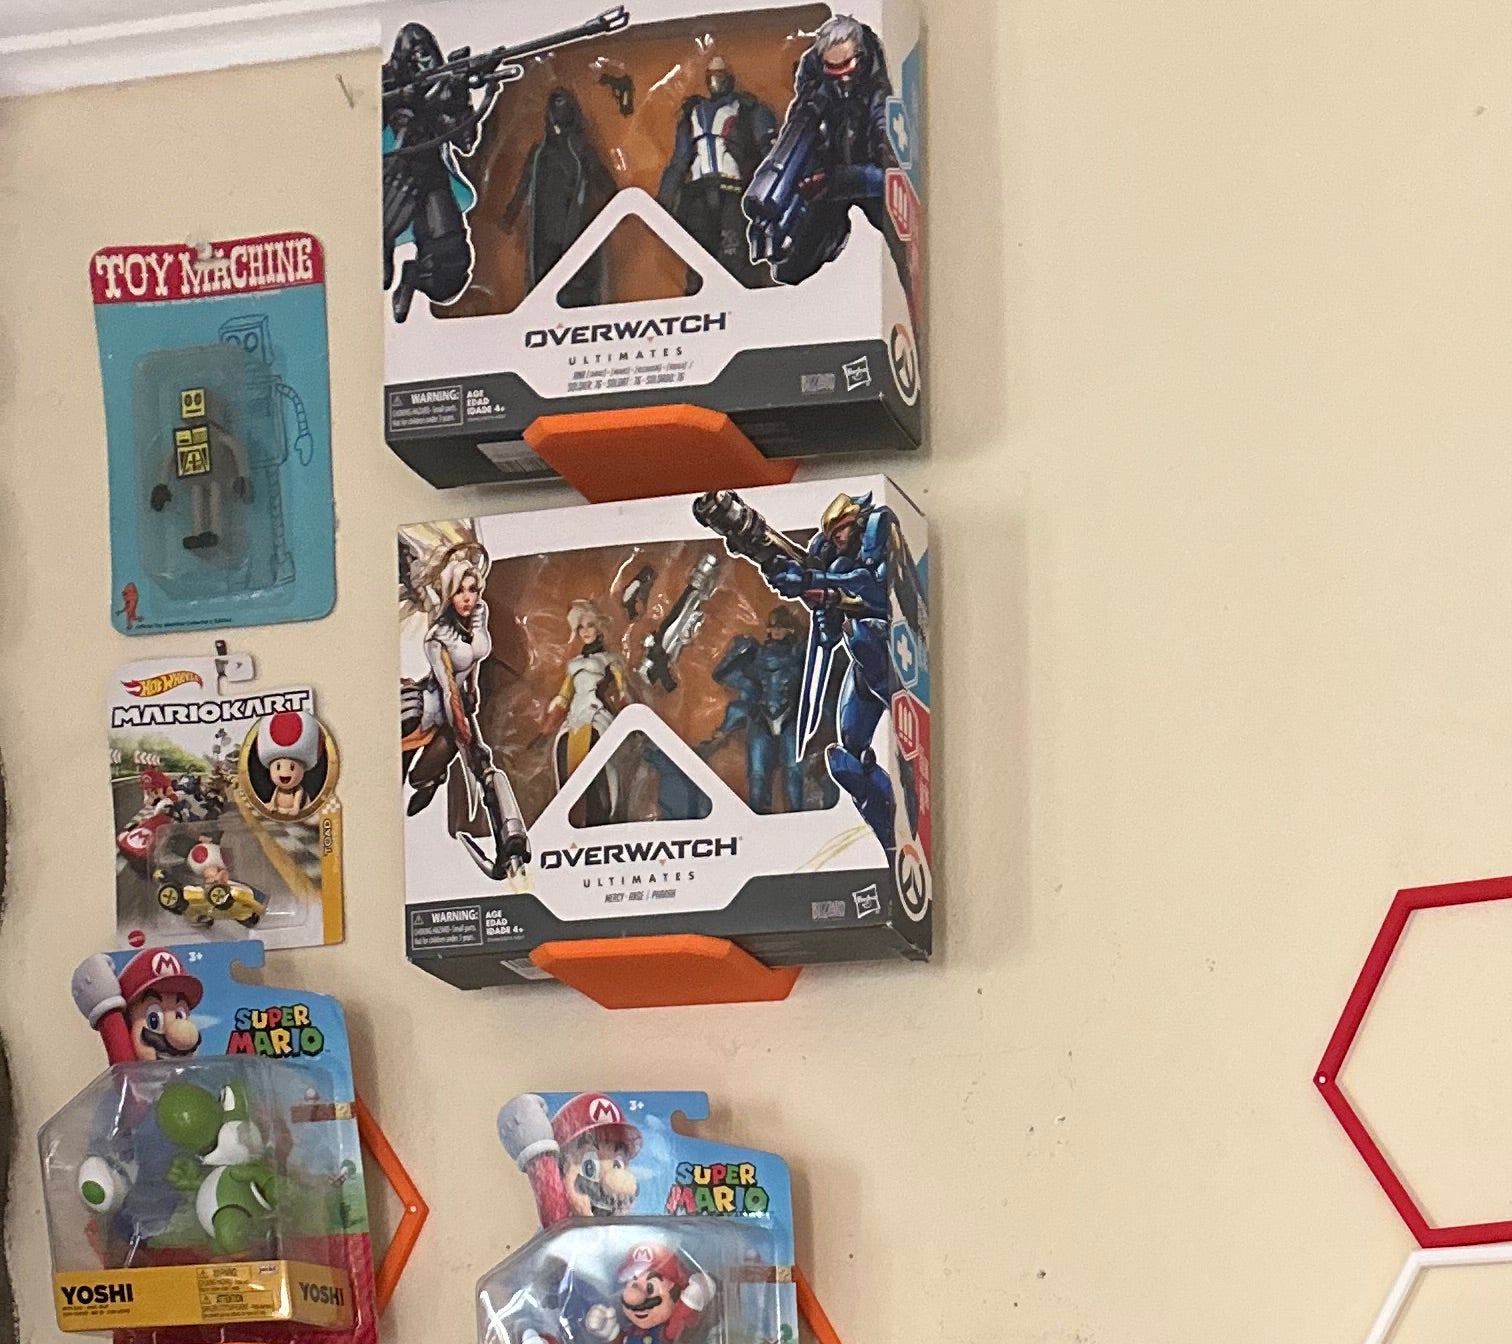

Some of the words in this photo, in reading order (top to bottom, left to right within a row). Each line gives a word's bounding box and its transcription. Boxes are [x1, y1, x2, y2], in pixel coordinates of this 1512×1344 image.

[96, 253, 172, 300] TOY
[179, 237, 314, 294] MACHINE
[525, 312, 727, 348] OVERWATCH
[568, 346, 682, 366] ULTIMATES
[322, 818, 333, 856] TOAD
[540, 837, 737, 869] OVERWATCH
[583, 871, 695, 888] ULTIMATES
[431, 909, 479, 923] WARNING:
[486, 910, 502, 918] AGE
[486, 918, 507, 927] EDAD
[235, 1003, 312, 1030] SUPER
[226, 1026, 324, 1057] MARIO
[629, 1100, 644, 1111] 3+
[675, 1161, 757, 1186] SUPER
[665, 1184, 770, 1215] MARIO
[61, 1283, 133, 1305] YOSHI
[300, 1282, 345, 1306] YOSHI
